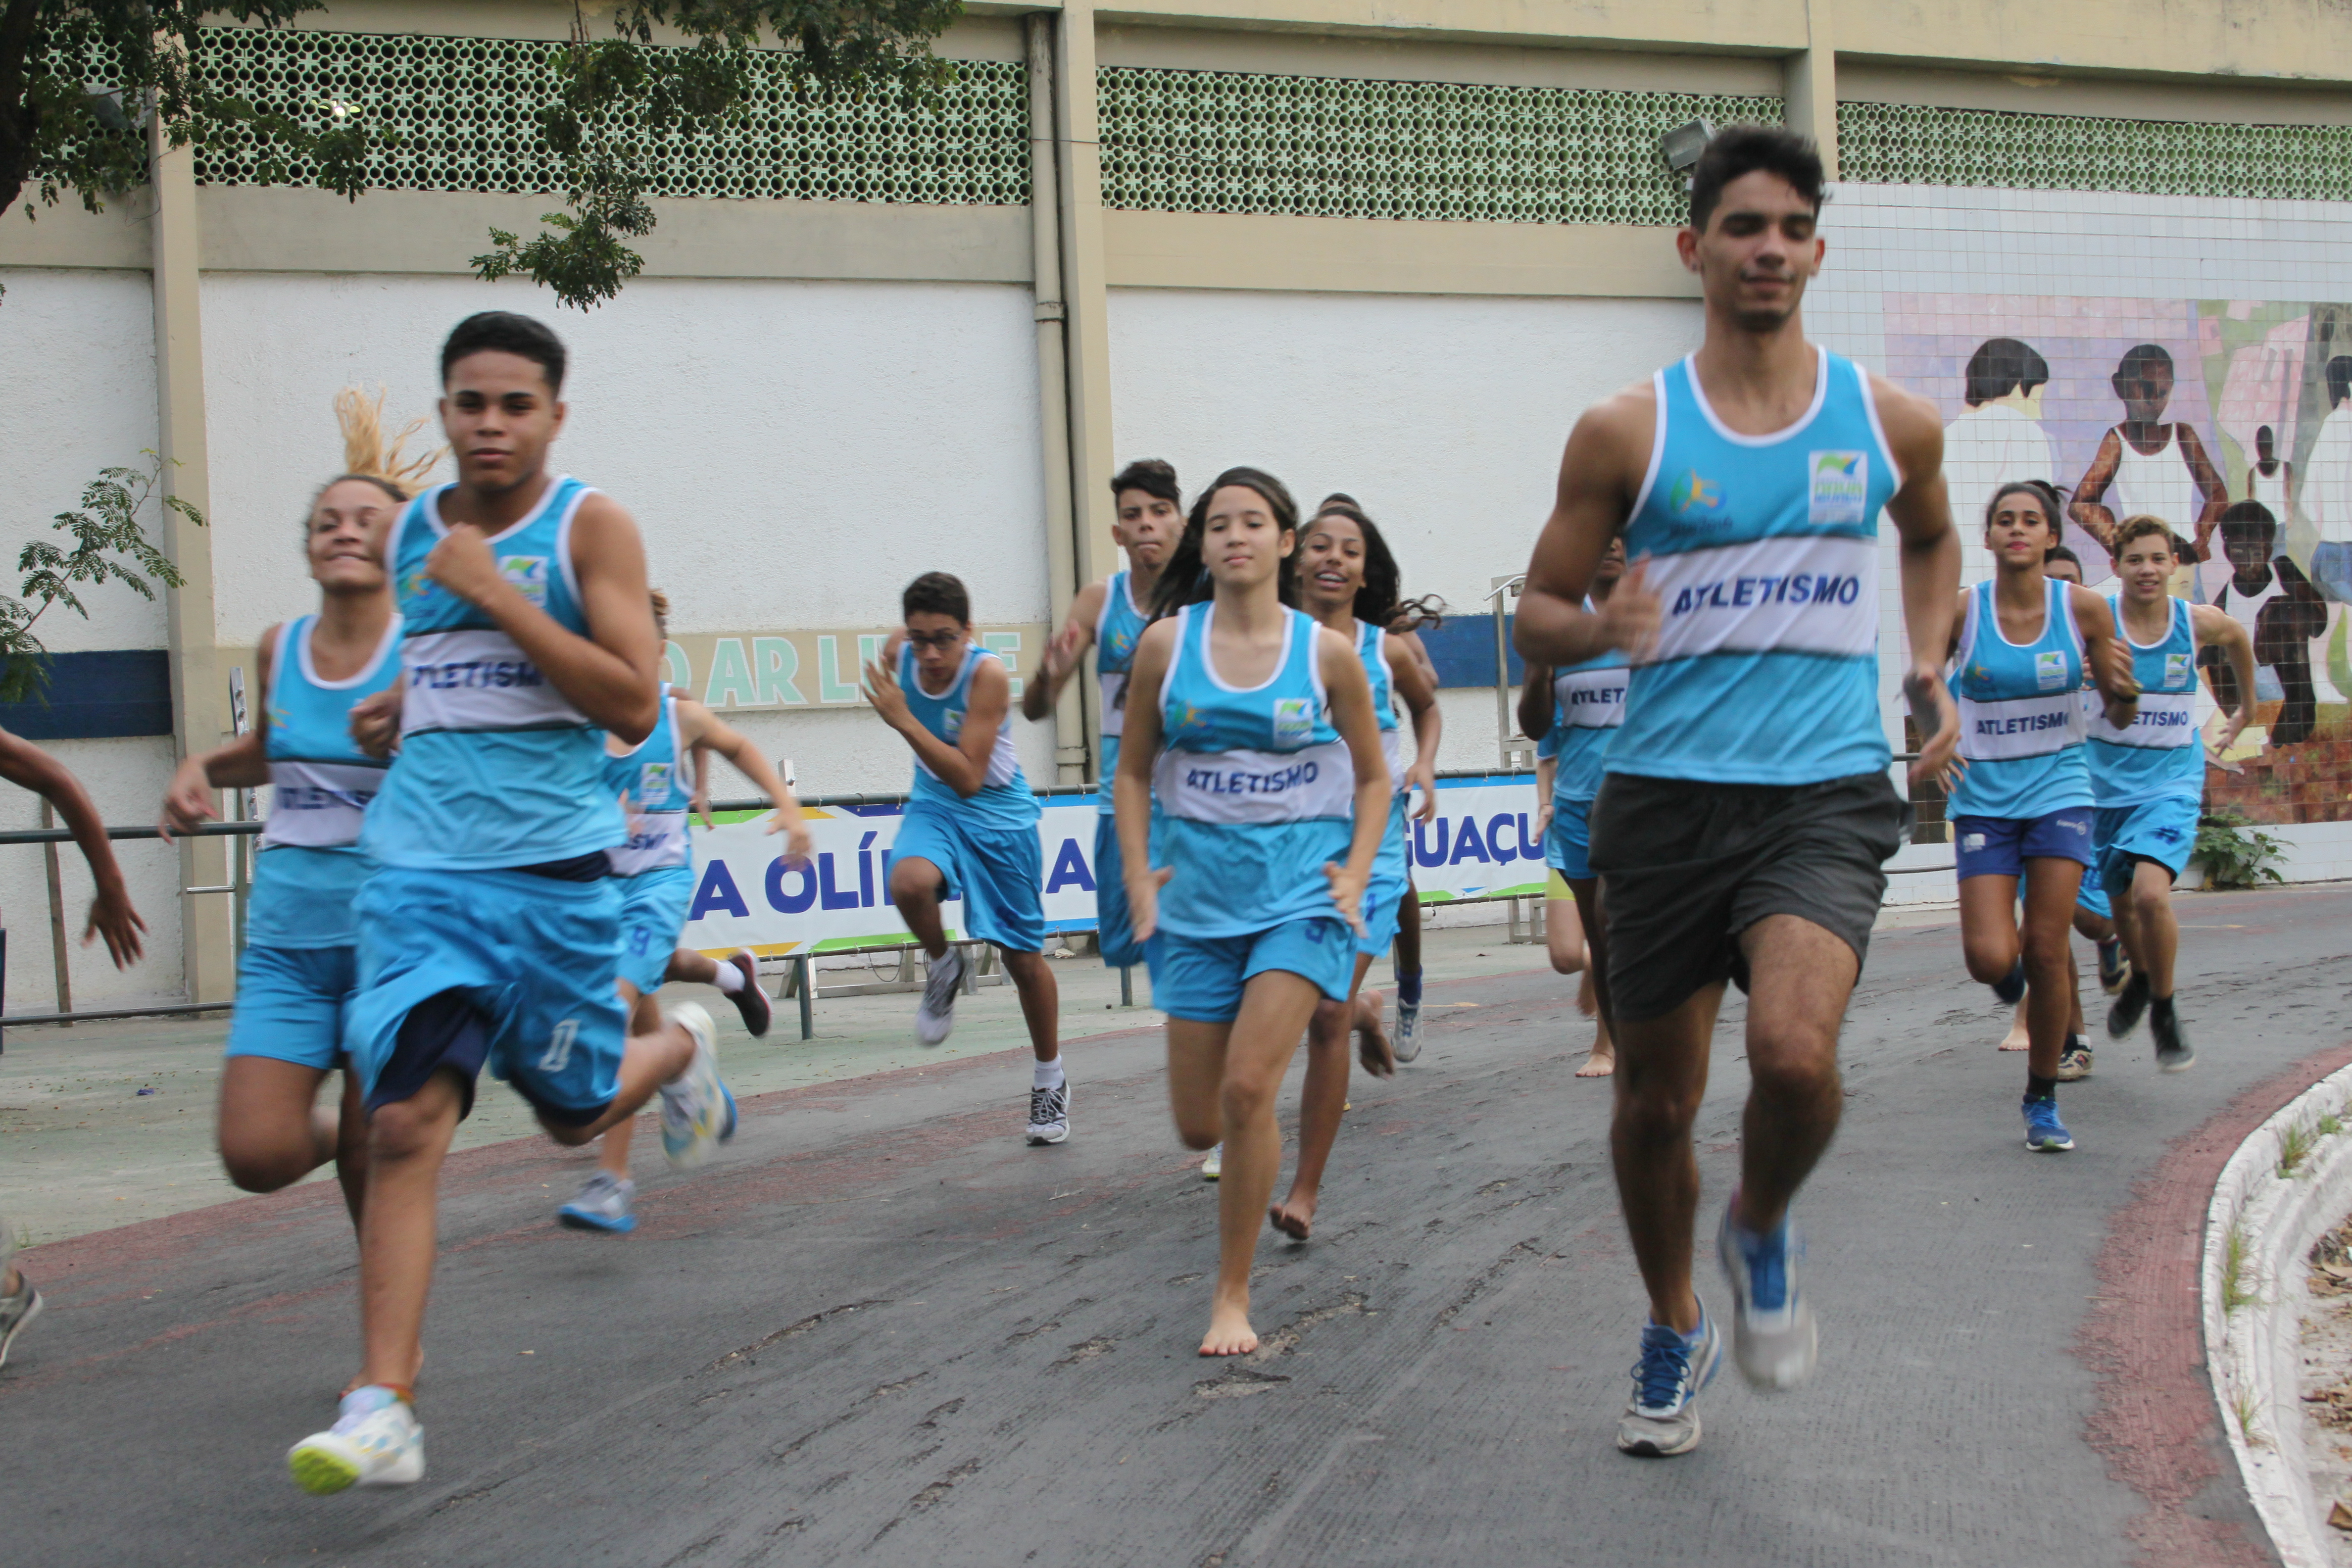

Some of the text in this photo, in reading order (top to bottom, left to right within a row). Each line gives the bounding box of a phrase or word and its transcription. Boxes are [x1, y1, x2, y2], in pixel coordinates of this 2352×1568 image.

[1672, 574, 1861, 617] ATLETISMO
[703, 637, 809, 708] AR
[817, 632, 1025, 703] LIE
[2101, 710, 2189, 726] ETISMO
[1187, 760, 1320, 794] ATLETISMO
[537, 1018, 582, 1072] 1
